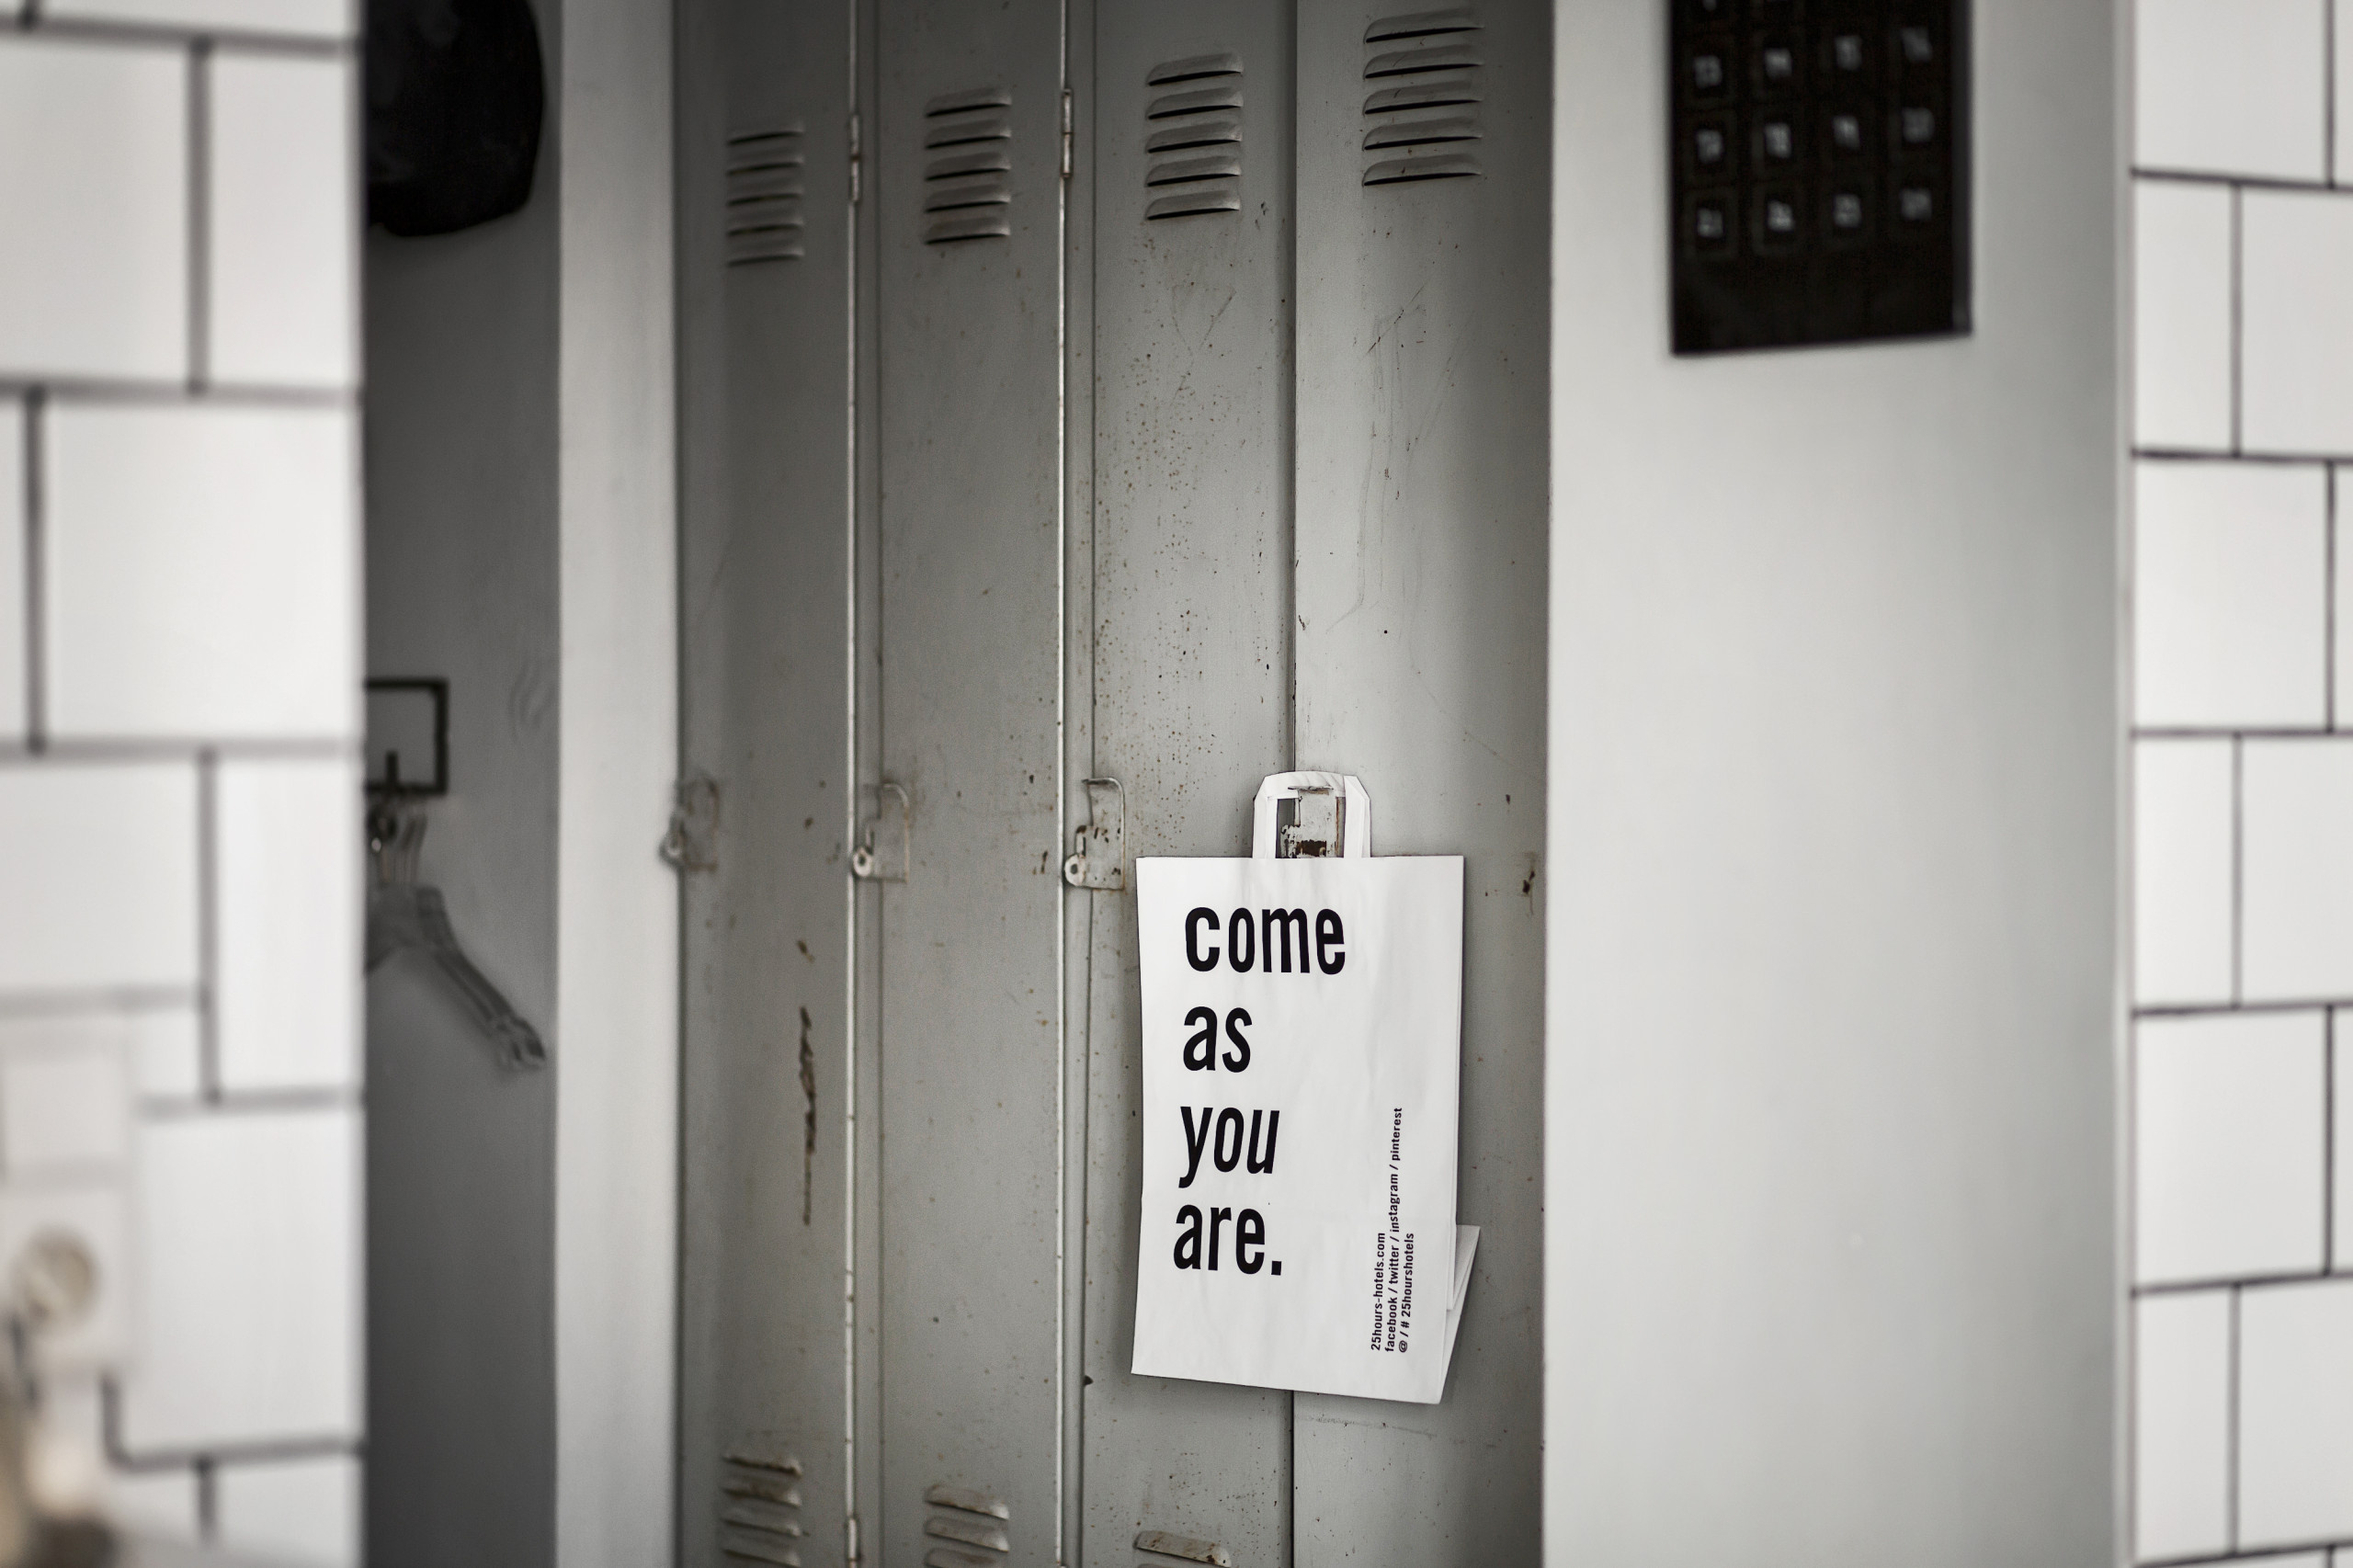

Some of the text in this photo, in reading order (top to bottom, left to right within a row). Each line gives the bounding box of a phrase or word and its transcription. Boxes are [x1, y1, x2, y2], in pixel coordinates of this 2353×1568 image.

[1185, 906, 1346, 975] come
[1183, 1006, 1253, 1074] as
[1177, 1107, 1280, 1189] you
[1390, 1108, 1403, 1161] pinterest
[1389, 1173, 1401, 1233] instagram
[1173, 1205, 1282, 1277] are.
[1388, 1244, 1399, 1285] twitter
[1370, 1232, 1385, 1351] 25hours-hotels.com
[1401, 1233, 1415, 1318] 25hourshotels
[1385, 1297, 1398, 1352] facebook
